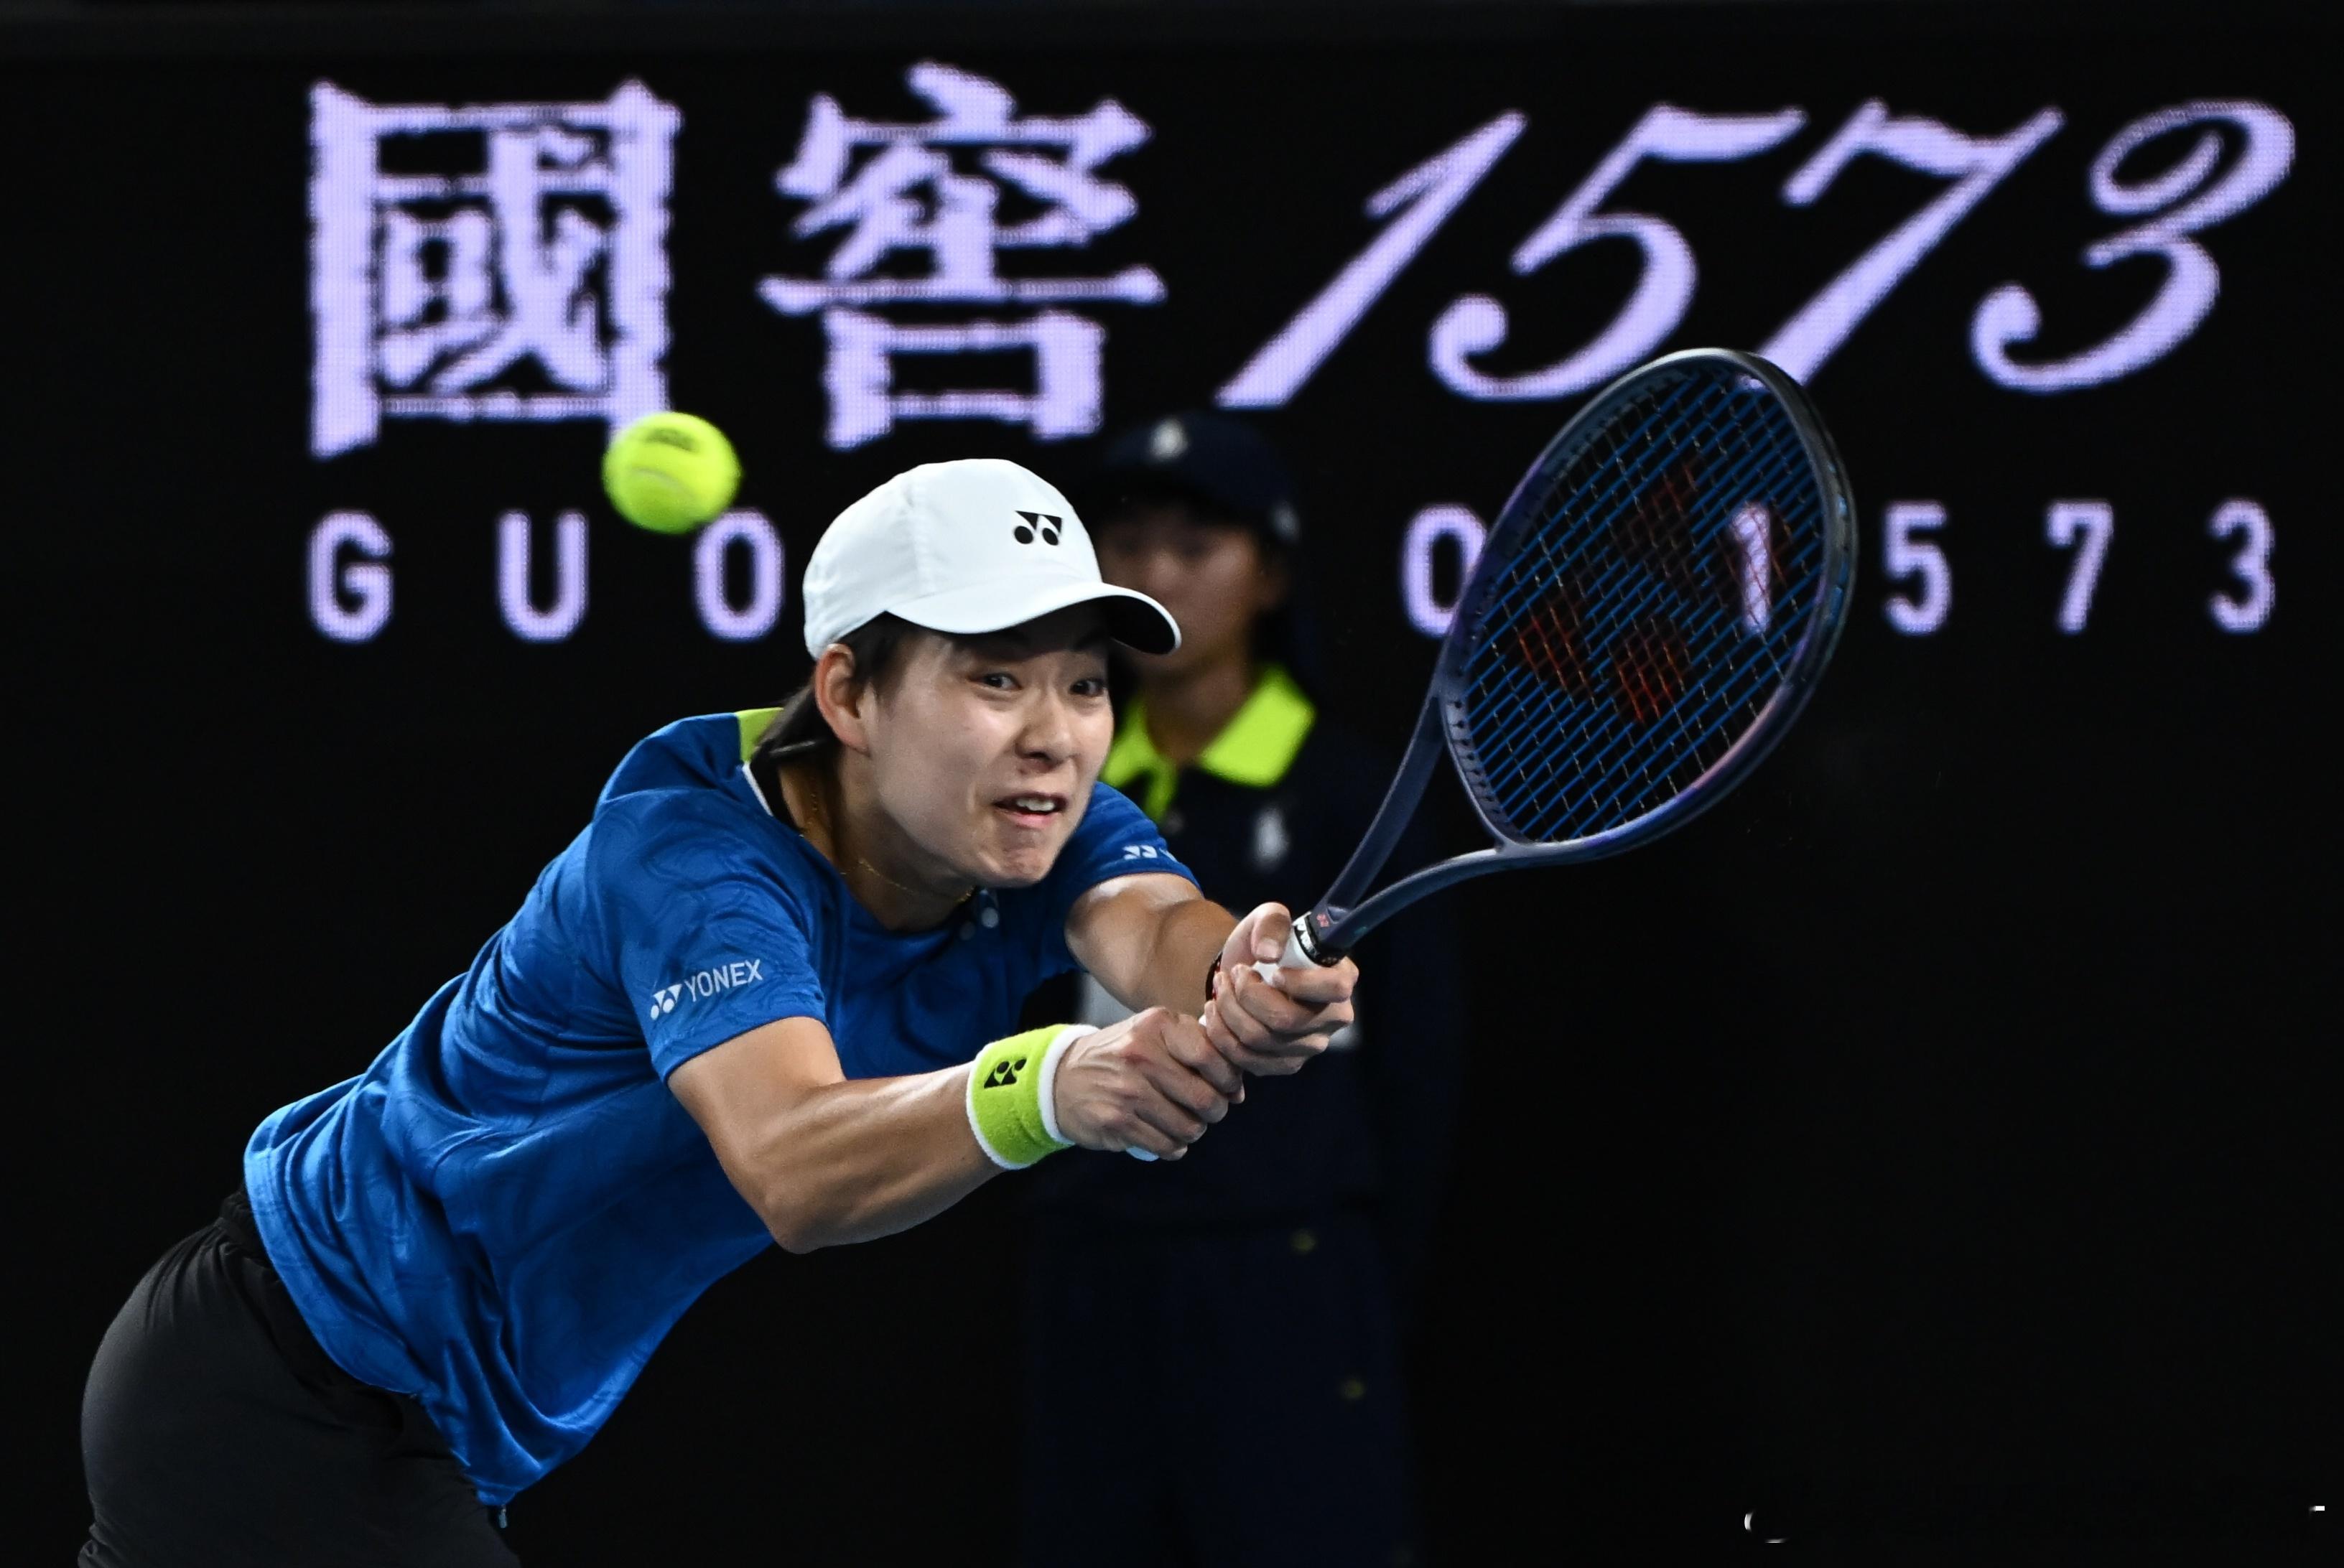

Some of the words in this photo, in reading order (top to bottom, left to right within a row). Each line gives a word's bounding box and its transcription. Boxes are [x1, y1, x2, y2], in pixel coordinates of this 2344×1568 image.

[310, 62, 1164, 457] 國窖
[1218, 101, 2296, 407] 1573
[309, 510, 783, 640] GUO
[1730, 500, 2276, 634] 1573
[684, 959, 763, 1002] YONEX
